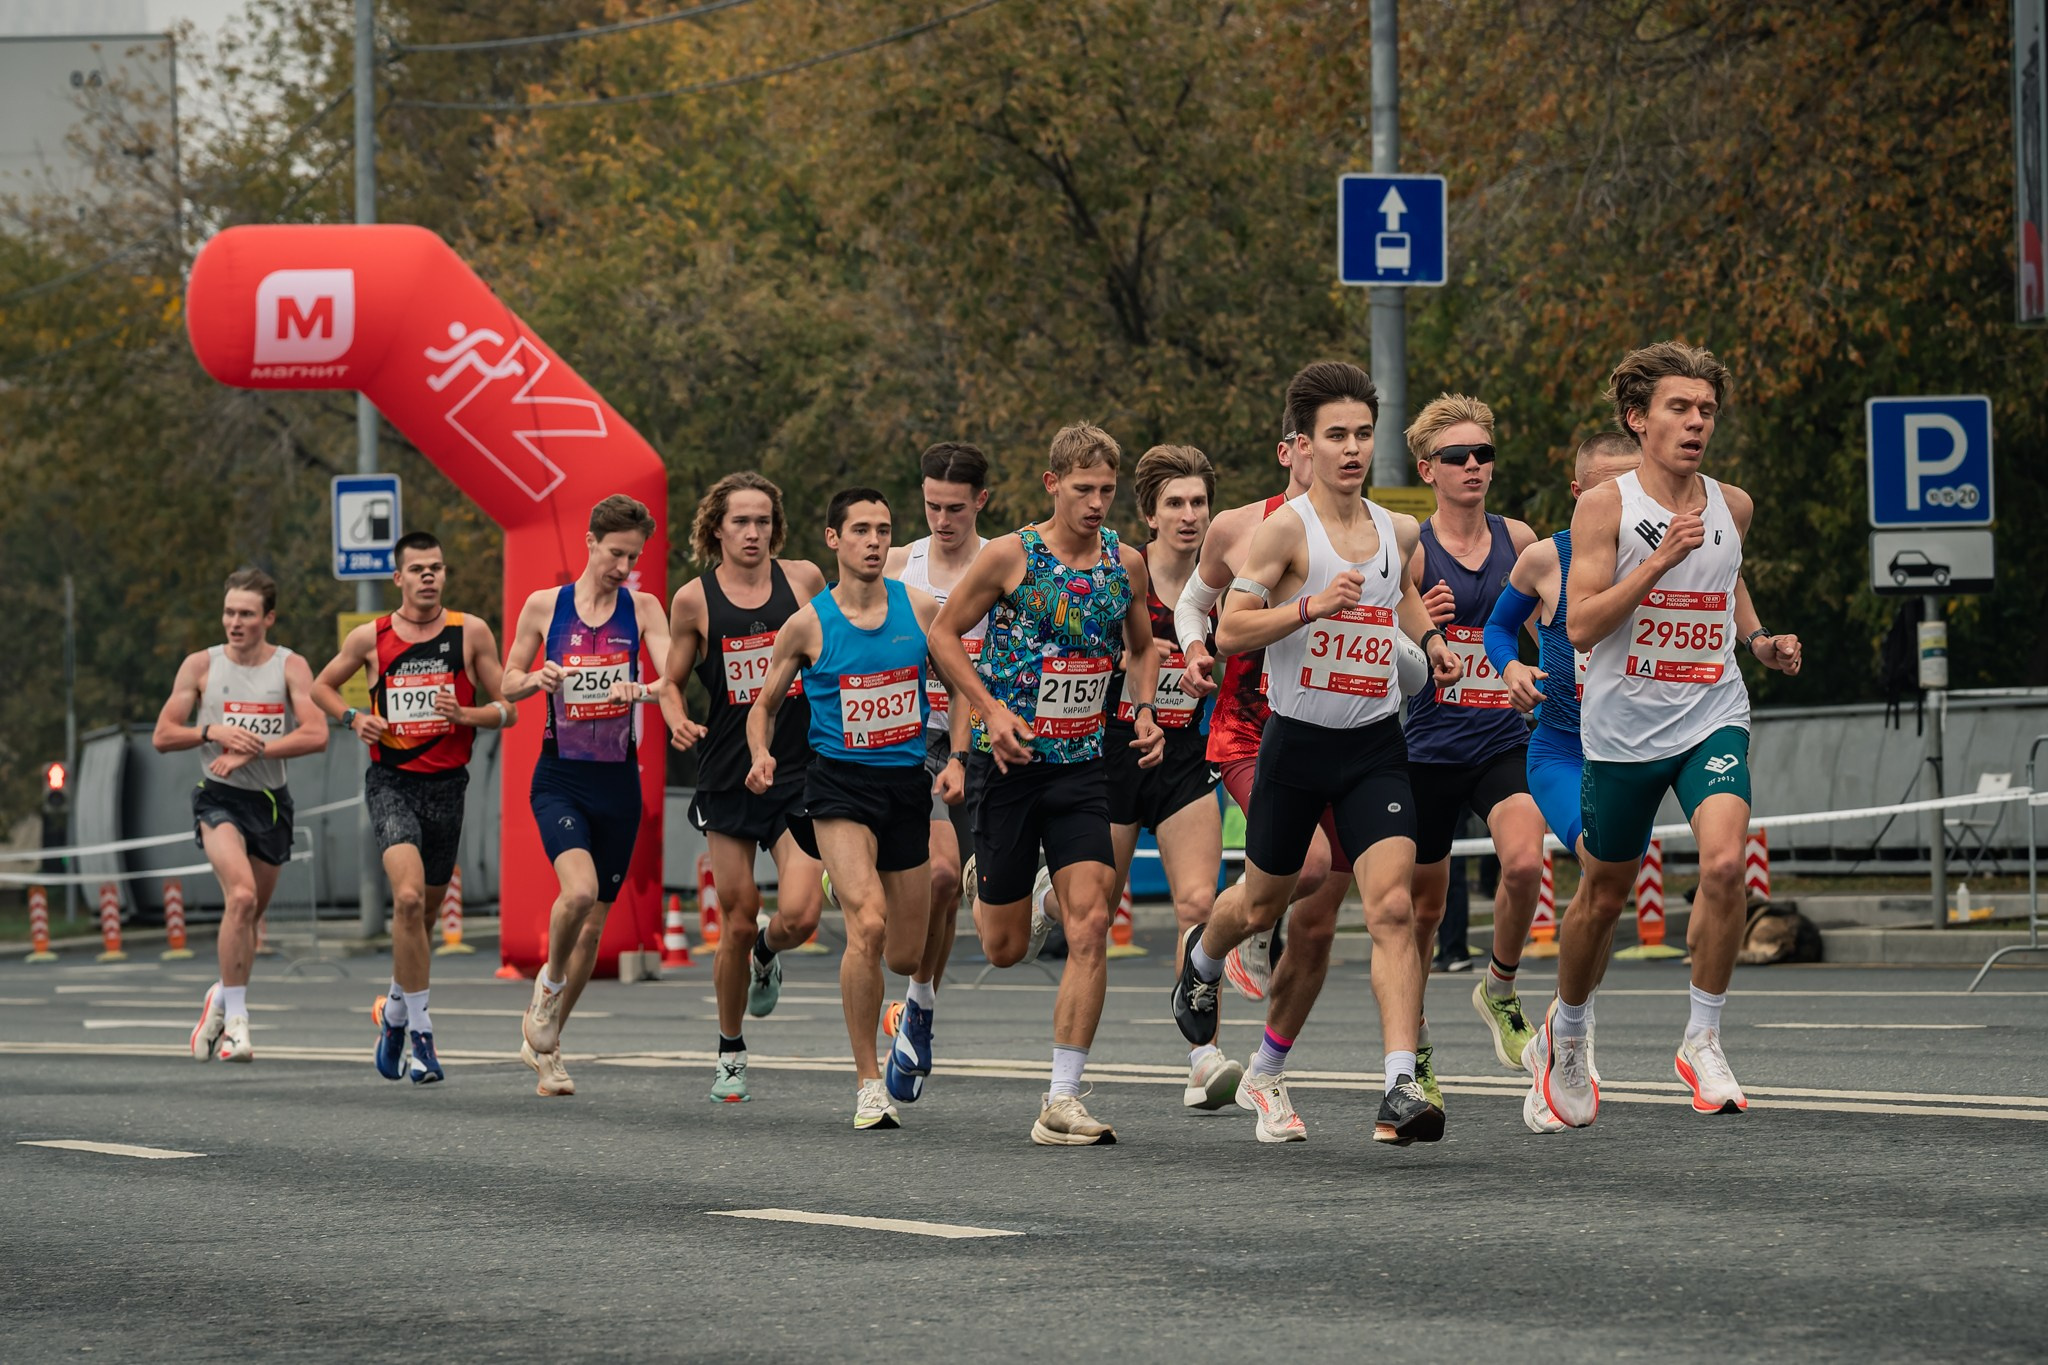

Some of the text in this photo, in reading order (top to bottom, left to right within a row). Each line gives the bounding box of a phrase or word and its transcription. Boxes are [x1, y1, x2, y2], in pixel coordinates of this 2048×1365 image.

[1904, 413, 1969, 511] P
[1959, 488, 1977, 504] 20
[1636, 618, 1724, 651] 29585
[1311, 630, 1393, 666] 31482
[572, 669, 623, 692] 2566
[728, 657, 773, 681] 319
[928, 681, 944, 689] КИР
[1042, 676, 1106, 704] 21531
[391, 689, 451, 712] 1990
[846, 689, 917, 722] 29837
[1063, 706, 1091, 714] КИРИЛЛ
[1155, 696, 1184, 707] КСАНДР
[1717, 775, 1735, 783] 2012
